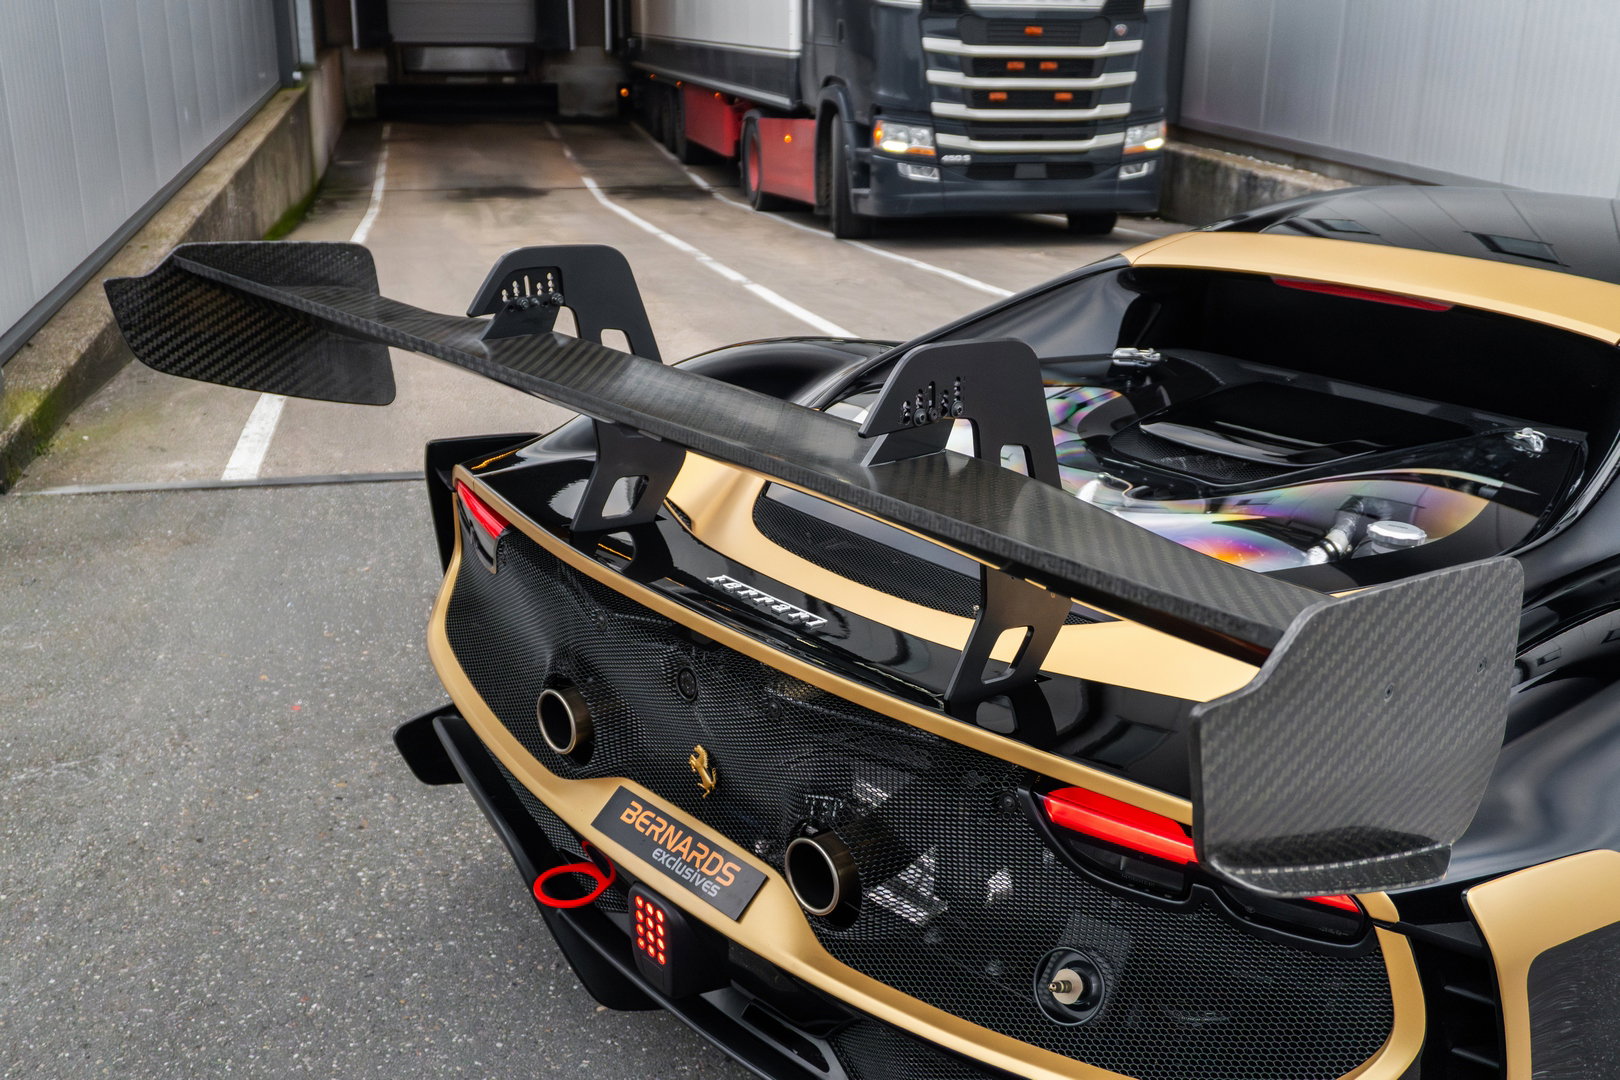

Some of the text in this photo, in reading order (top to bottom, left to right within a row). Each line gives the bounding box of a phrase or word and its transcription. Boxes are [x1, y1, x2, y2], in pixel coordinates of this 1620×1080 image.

[706, 575, 827, 628] Ferrari
[620, 801, 741, 887] BERNARDS
[652, 848, 720, 897] exclusives
